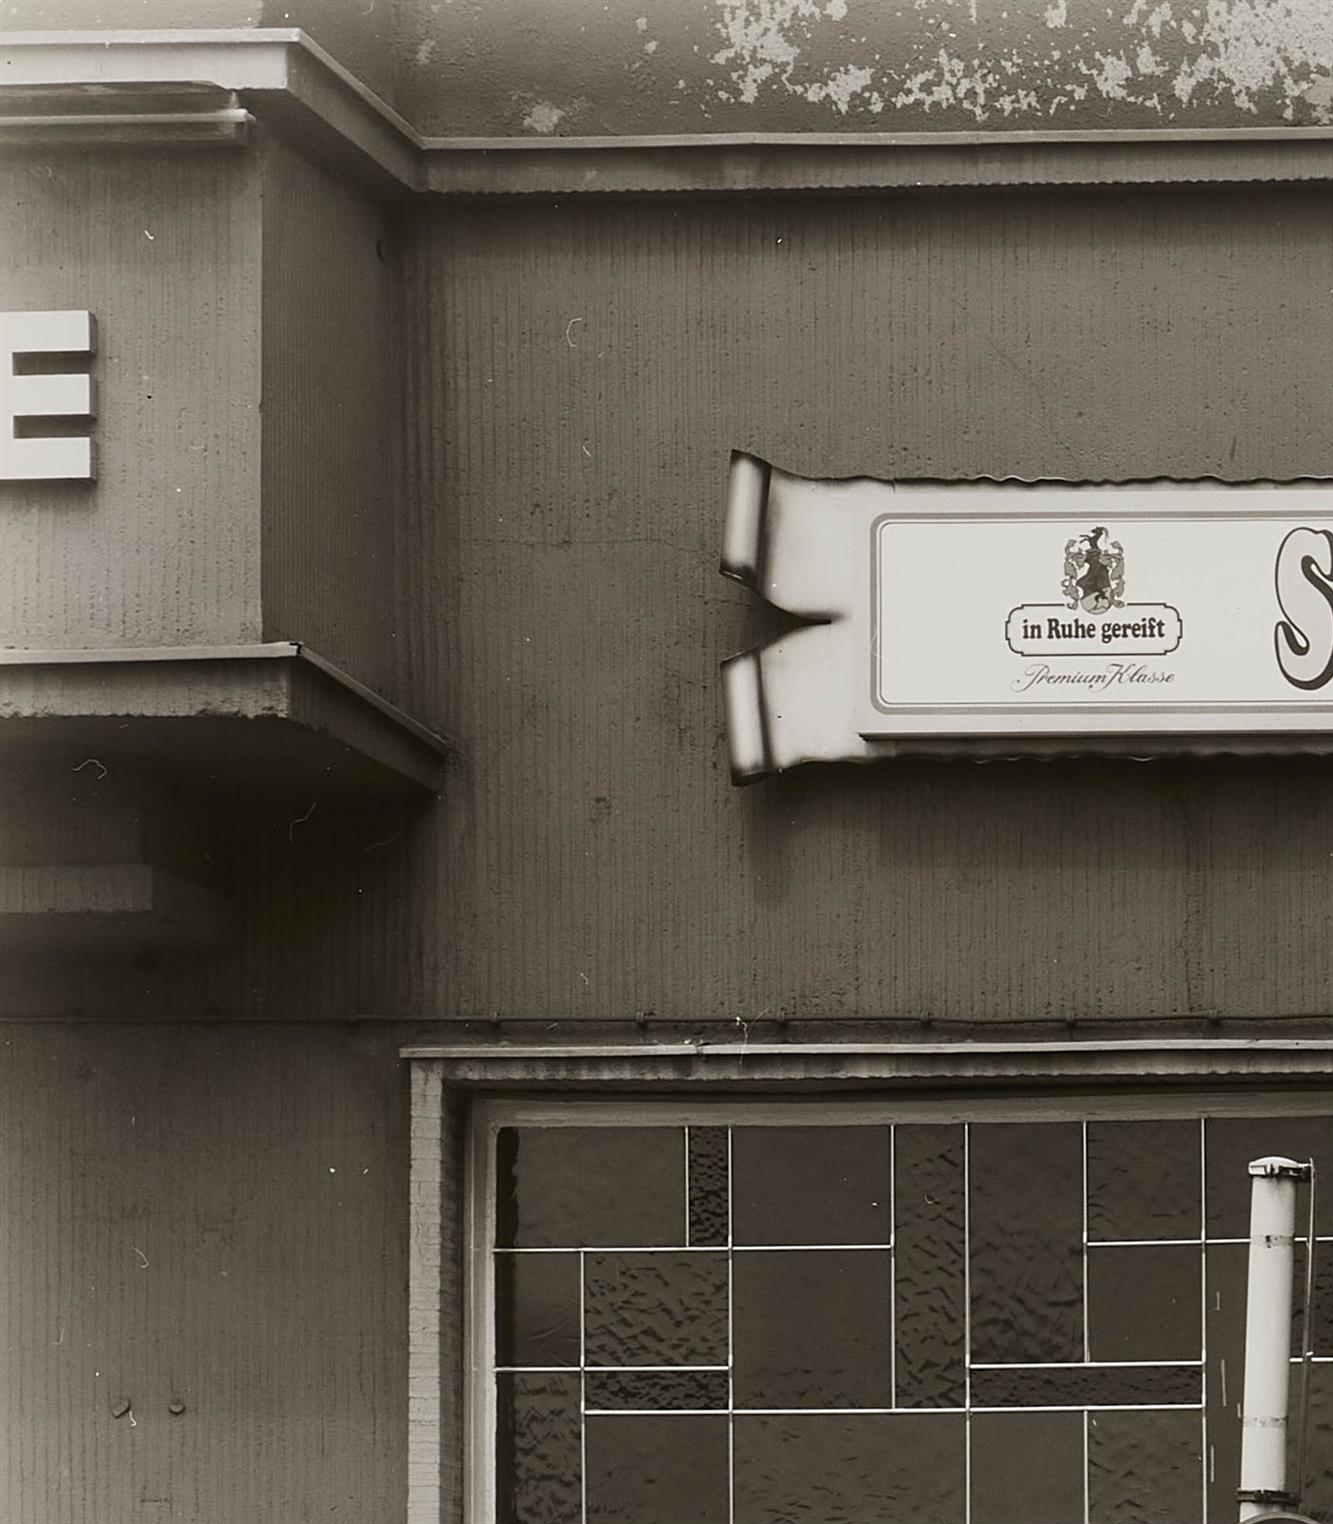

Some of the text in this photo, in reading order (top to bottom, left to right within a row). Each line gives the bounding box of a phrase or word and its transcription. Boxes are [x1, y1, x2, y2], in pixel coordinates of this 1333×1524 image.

[1022, 617, 1165, 643] in Ruhe gereift
